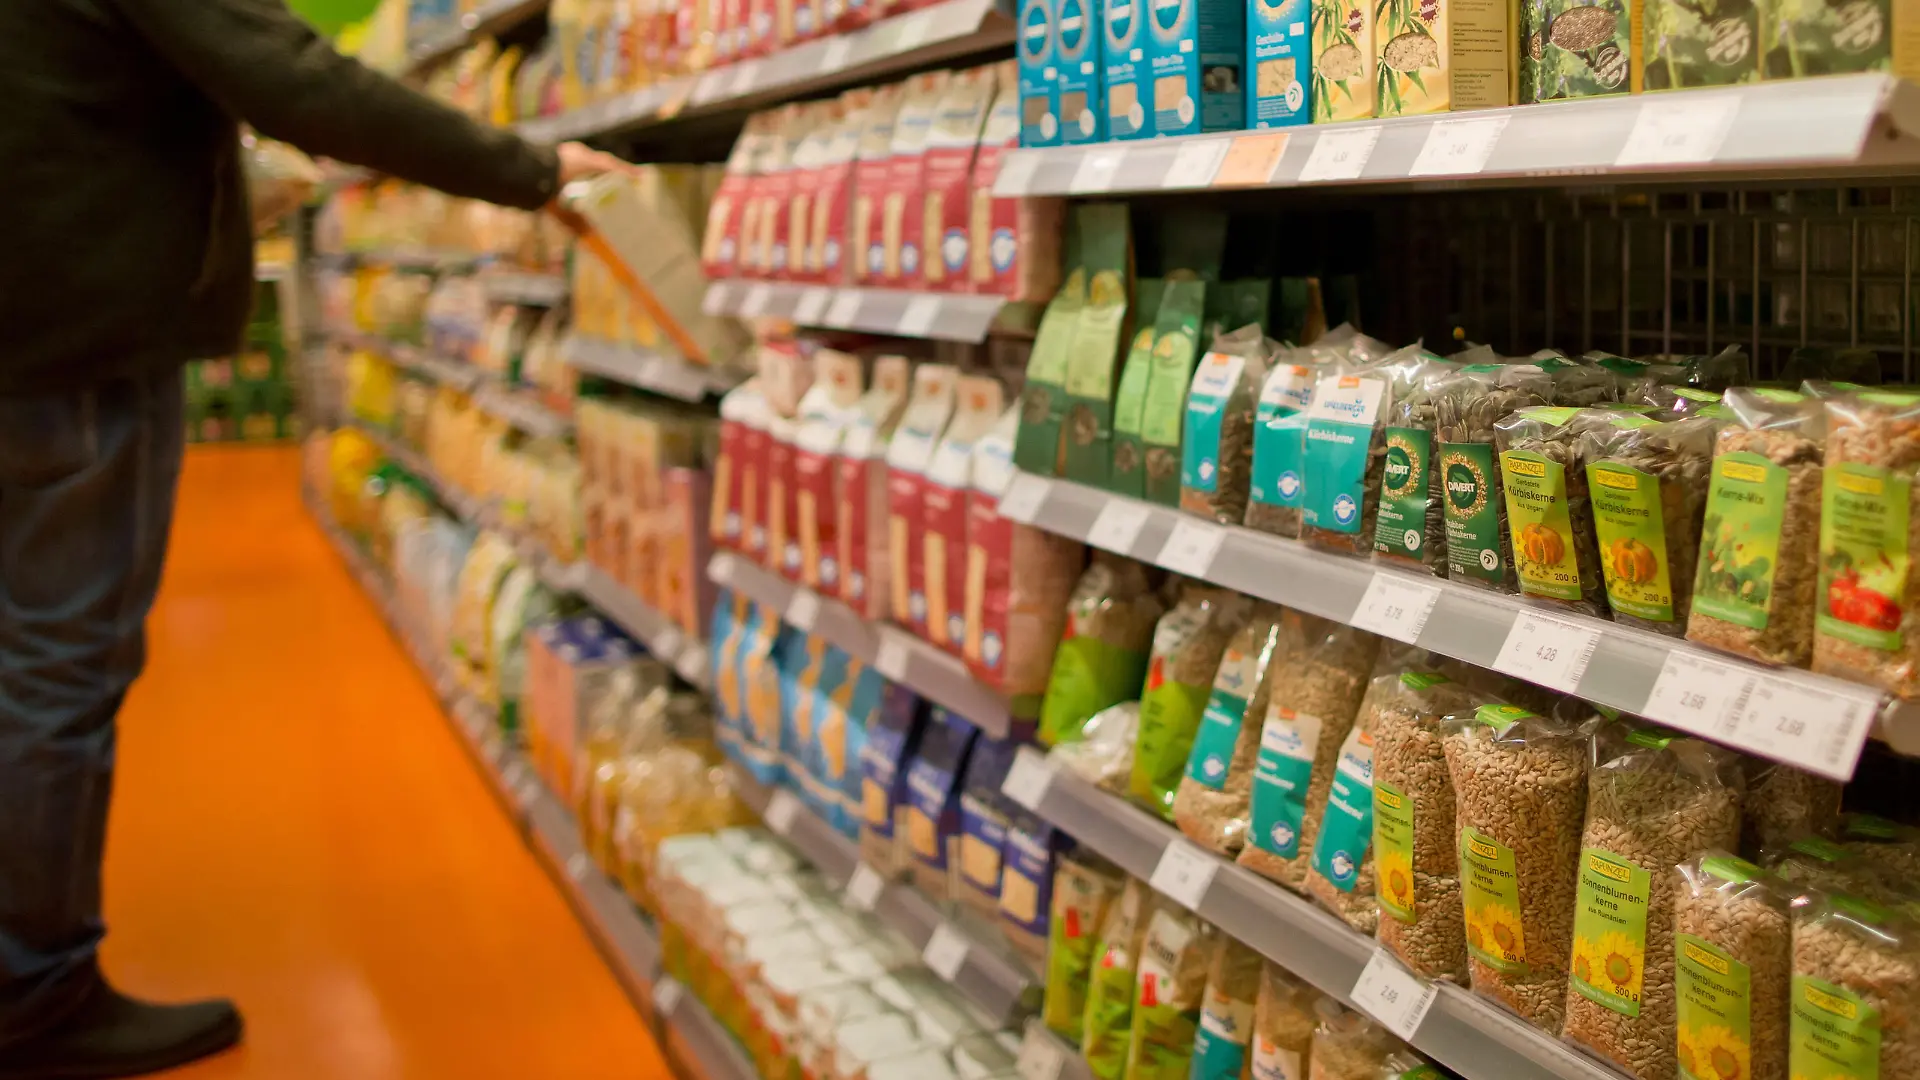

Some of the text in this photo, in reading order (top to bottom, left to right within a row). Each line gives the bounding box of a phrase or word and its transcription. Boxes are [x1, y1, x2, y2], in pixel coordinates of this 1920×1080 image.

[1508, 459, 1545, 476] RAPUNZEL
[1448, 481, 1475, 493] DAVERT
[1515, 478, 1540, 489] Geröstete
[1507, 484, 1556, 504] Kürbiskerne
[1716, 486, 1765, 505] Kerne-Mix
[1526, 503, 1545, 513] Ungarn
[1594, 499, 1650, 518] Kürbiskerne
[1554, 572, 1578, 583] 200 g
[1643, 592, 1669, 605] 200 g
[1591, 857, 1629, 880] RAPUNZEL
[1473, 870, 1494, 886] kerne
[1582, 874, 1645, 905] Sonnenblumen-
[1595, 894, 1619, 912] kerne
[1597, 909, 1628, 926] Rumänien
[1502, 950, 1517, 962] 500
[1686, 944, 1729, 973] RAPUNZEL
[1677, 958, 1742, 998] Sonnenblumen-
[1614, 985, 1638, 1002] 500 g
[1692, 983, 1716, 1003] kerne
[1812, 1031, 1841, 1051] kerne
